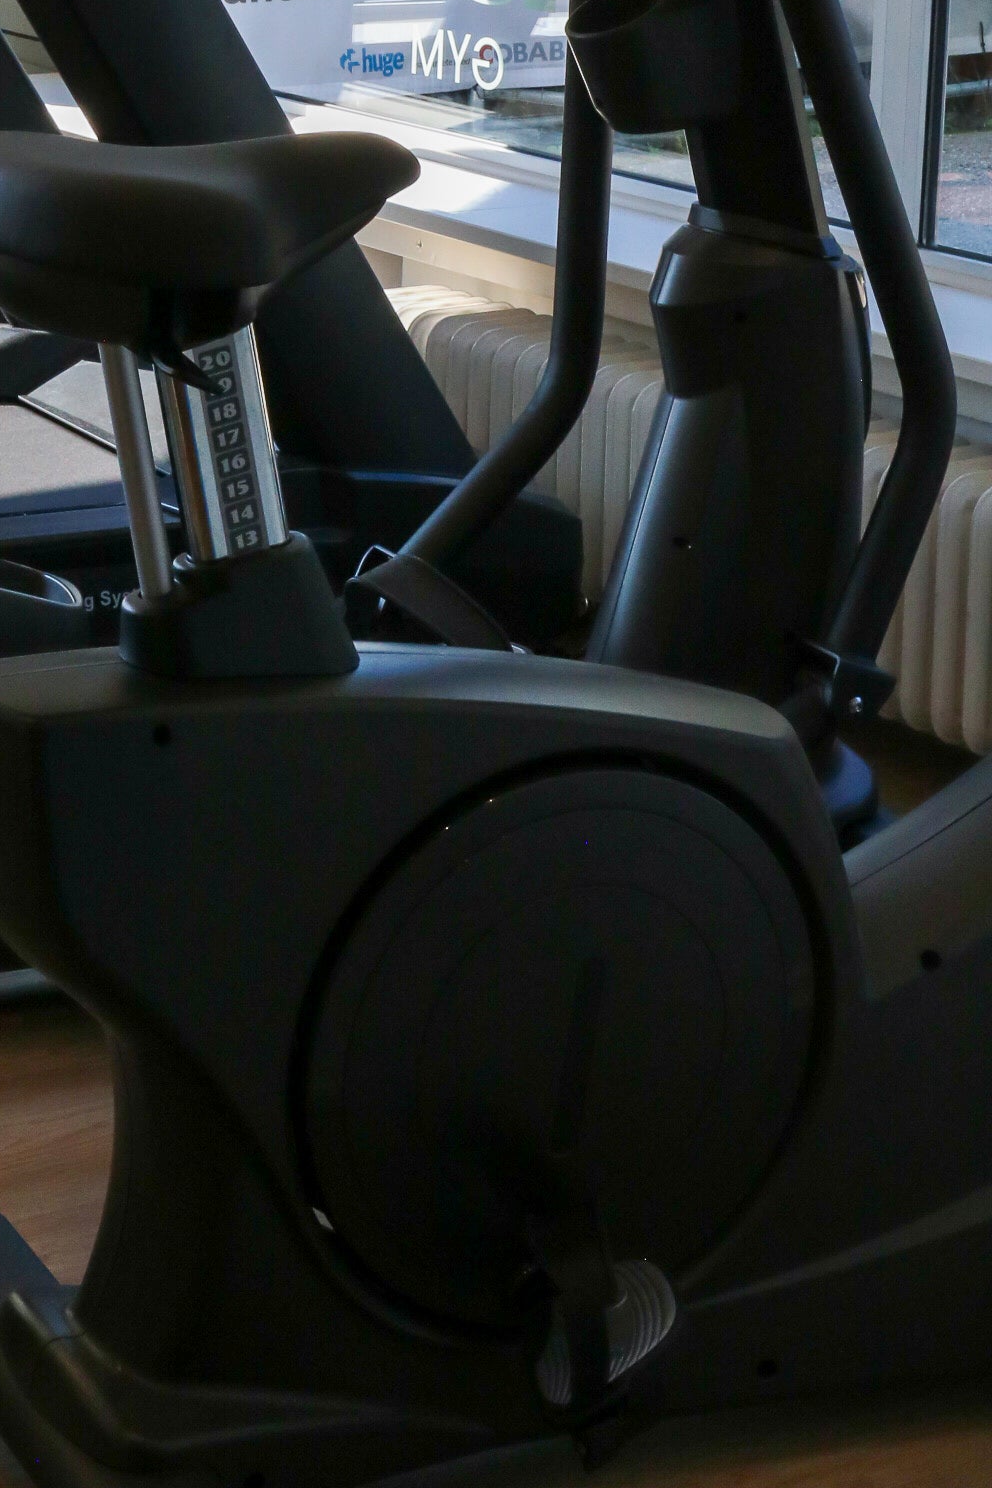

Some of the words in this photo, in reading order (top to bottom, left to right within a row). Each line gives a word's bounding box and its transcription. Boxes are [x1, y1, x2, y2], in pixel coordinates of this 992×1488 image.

[362, 47, 405, 77] huge
[201, 351, 230, 371] 20
[212, 403, 237, 422] 18
[217, 428, 239, 447] 17
[221, 454, 246, 473] 16
[227, 480, 249, 498] 15
[231, 504, 254, 524] 14
[235, 530, 258, 549] 13
